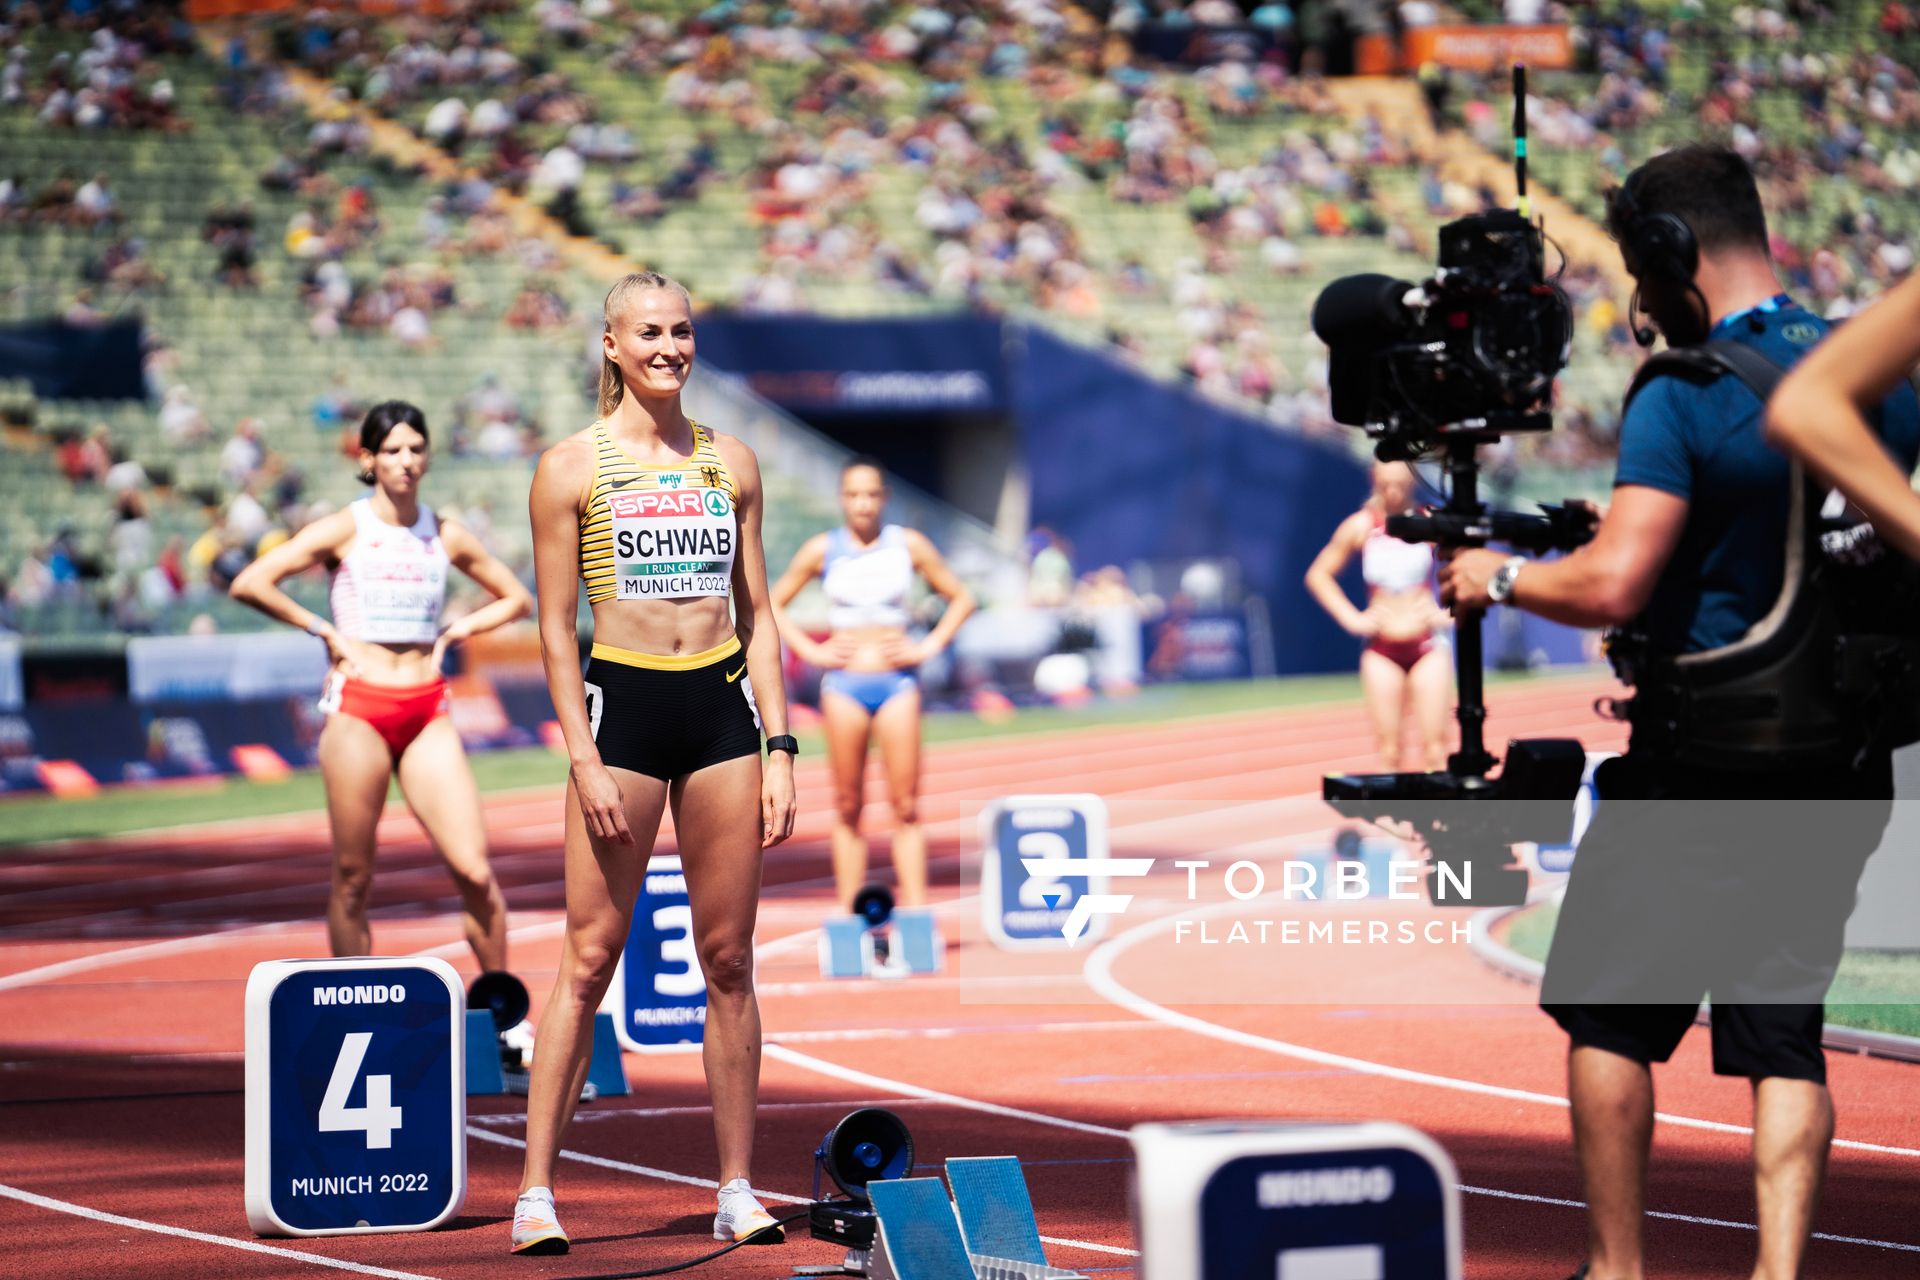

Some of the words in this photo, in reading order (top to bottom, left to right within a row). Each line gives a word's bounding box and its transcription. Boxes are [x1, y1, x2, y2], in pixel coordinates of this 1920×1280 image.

[614, 493, 702, 515] SPAR
[617, 528, 731, 558] SCHWAB
[652, 564, 675, 574] RUN
[625, 577, 692, 594] MUNICH
[697, 576, 726, 591] 2022
[1017, 831, 1073, 909] 2
[653, 905, 708, 997] 3
[313, 984, 406, 1005] MONDO
[318, 1032, 402, 1149] 4
[292, 1175, 373, 1196] MUNICH
[379, 1173, 429, 1193] 2022
